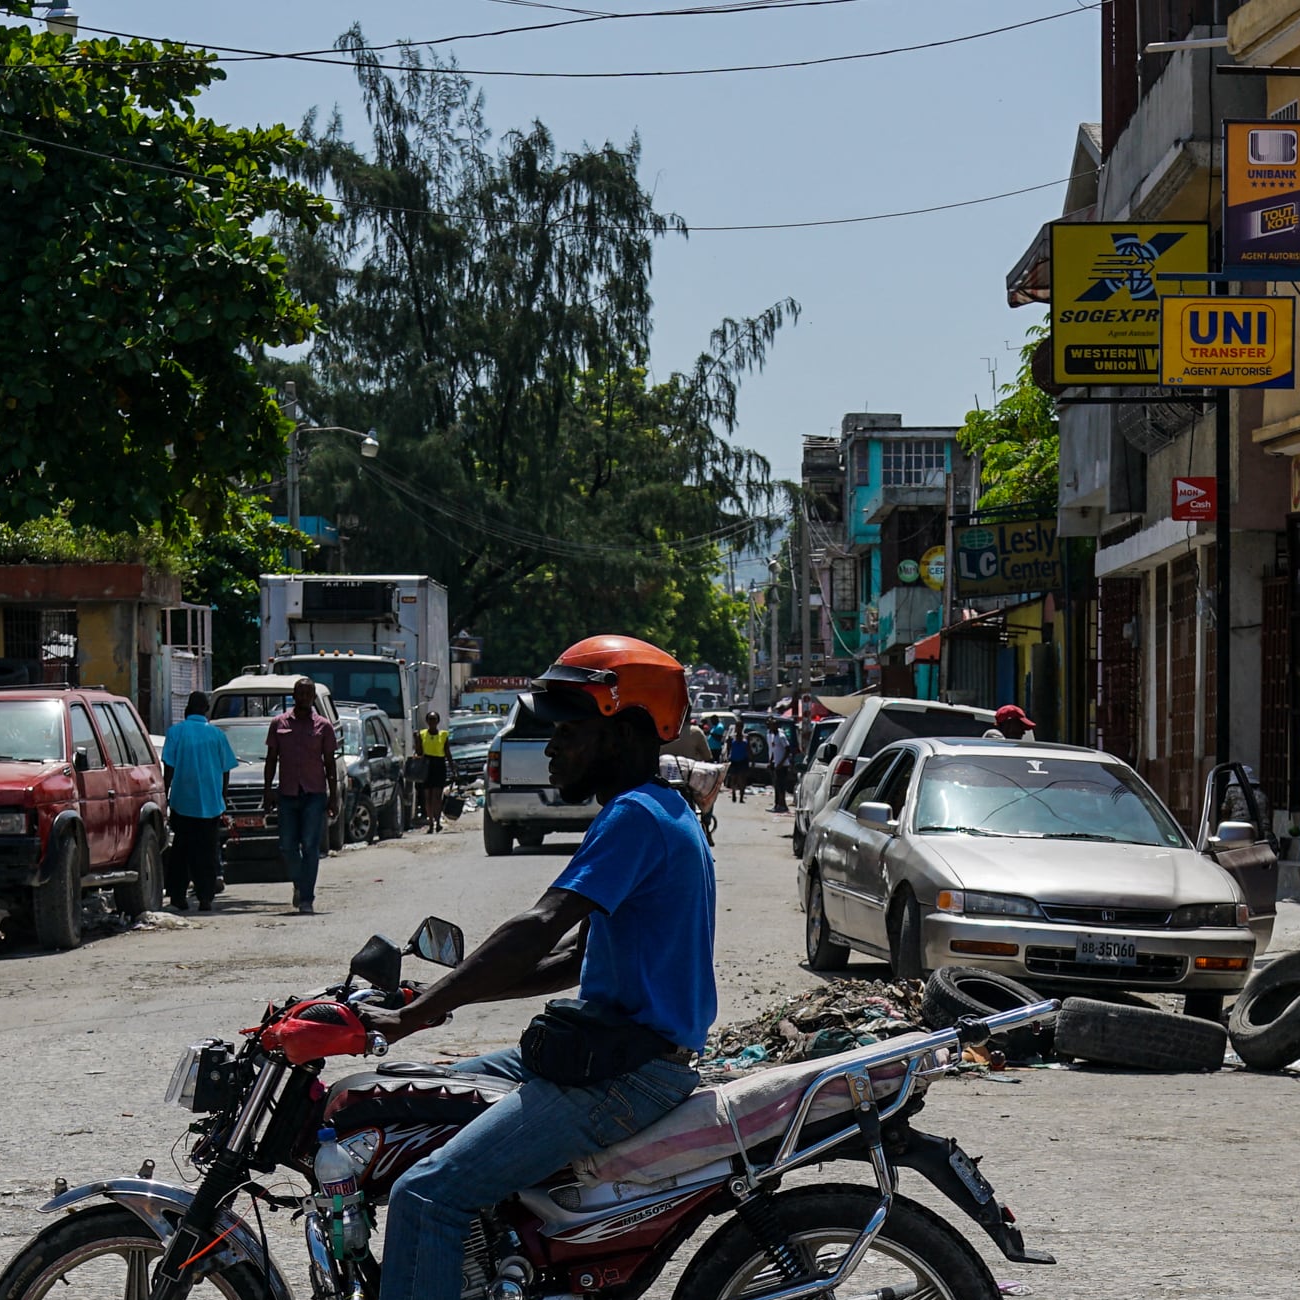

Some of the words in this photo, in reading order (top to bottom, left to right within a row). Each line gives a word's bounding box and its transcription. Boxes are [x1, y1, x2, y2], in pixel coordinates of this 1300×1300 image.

[1247, 169, 1297, 179] UNIBANK
[1262, 205, 1294, 221] TOUT
[1241, 252, 1267, 261] AGENT
[1189, 310, 1267, 345] UNI
[1070, 348, 1137, 358] WESTERN
[1189, 348, 1267, 358] TRANSFER
[1094, 360, 1137, 371] UNION
[1182, 366, 1219, 376] AGENT
[1179, 489, 1199, 497] MON
[1189, 500, 1212, 509] Cash
[999, 522, 1057, 557] Lesly
[958, 551, 997, 580] LC
[1000, 556, 1060, 581] Center
